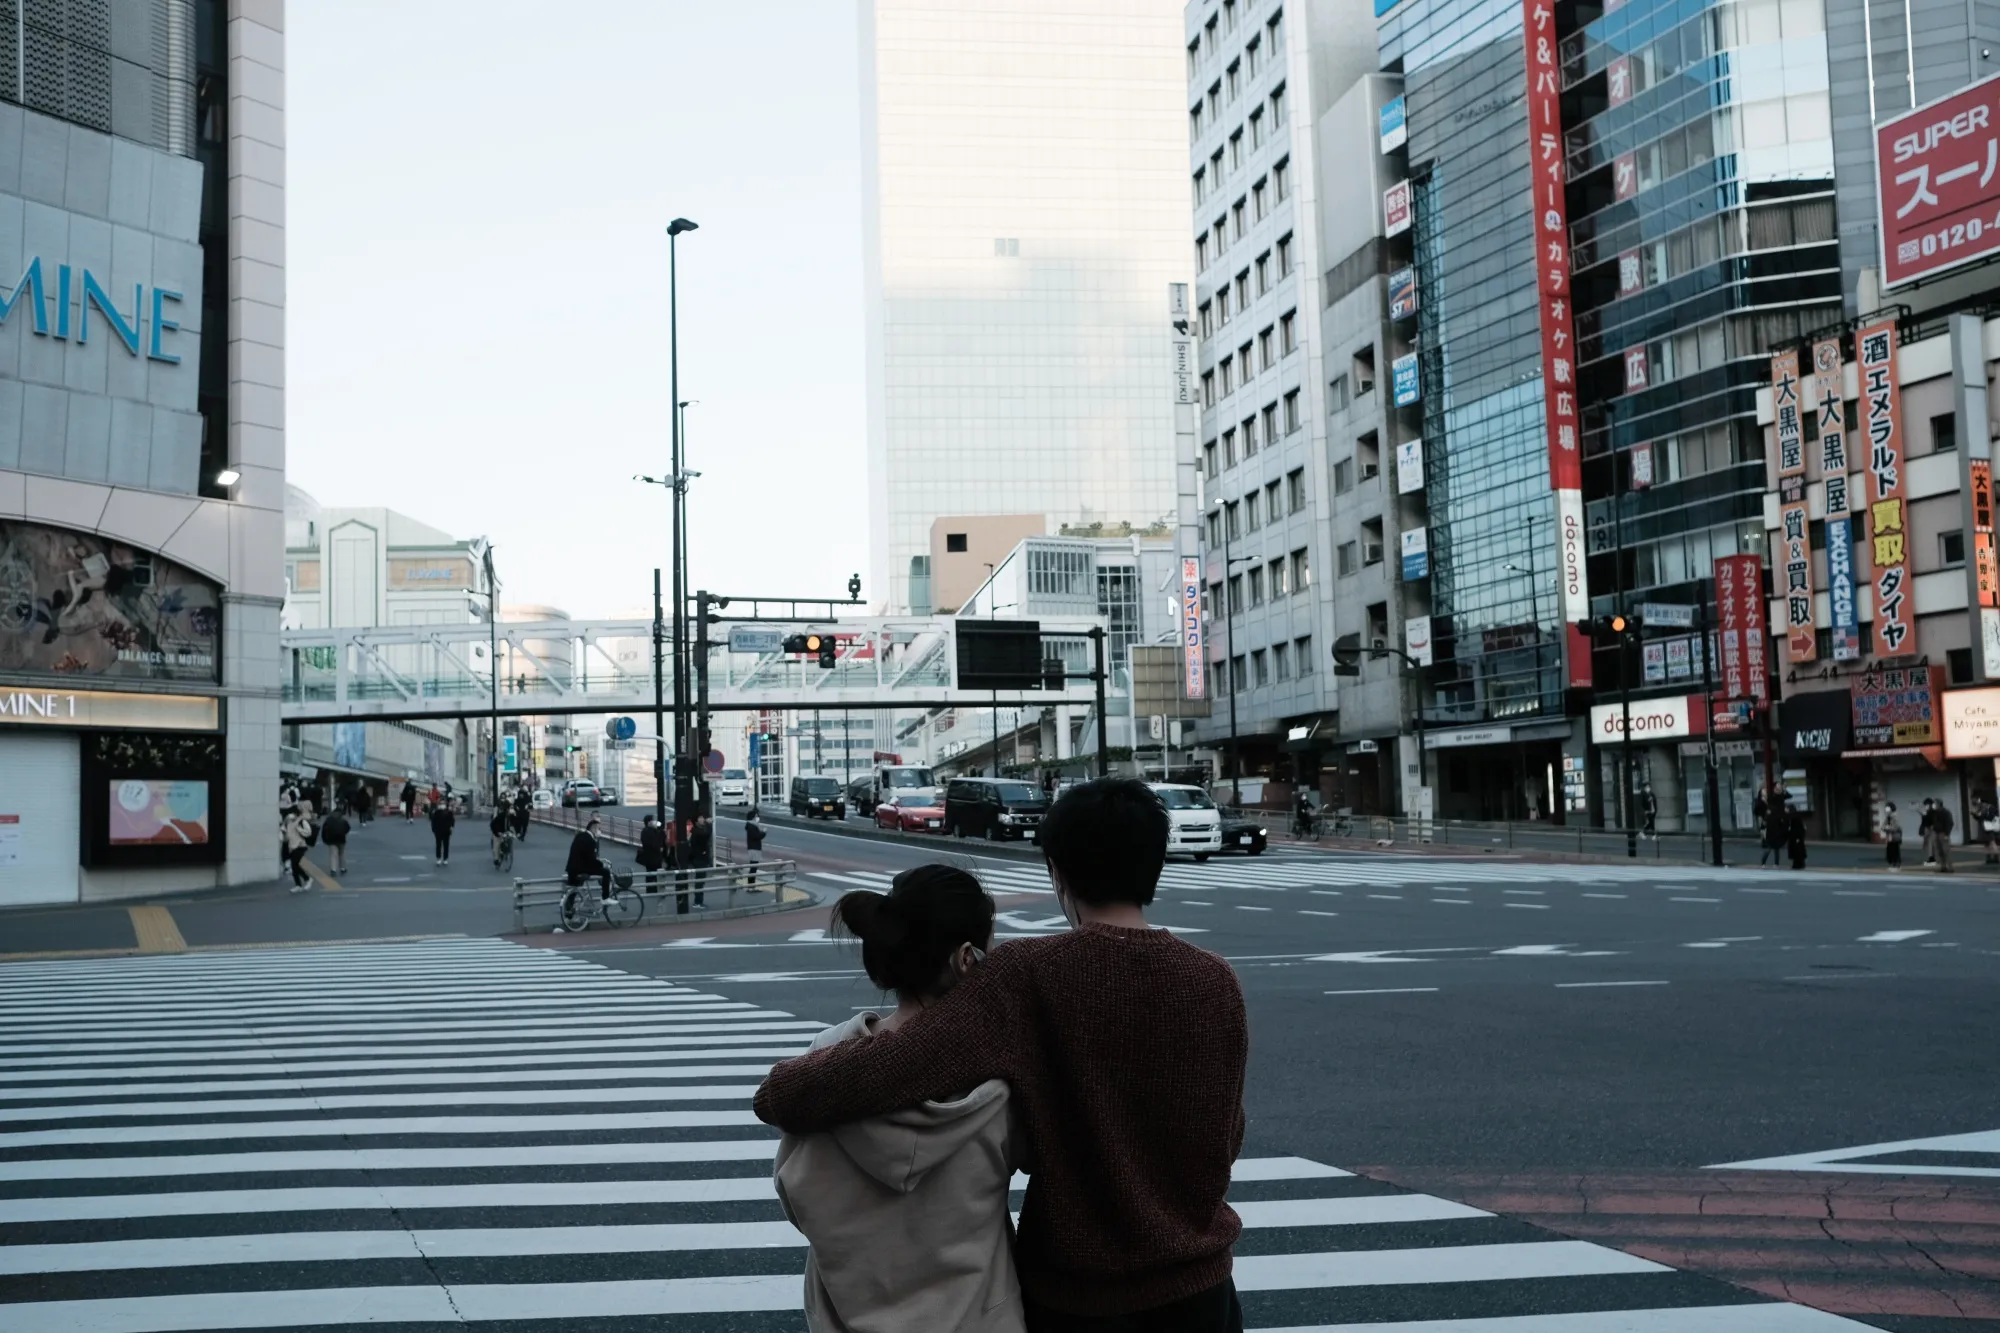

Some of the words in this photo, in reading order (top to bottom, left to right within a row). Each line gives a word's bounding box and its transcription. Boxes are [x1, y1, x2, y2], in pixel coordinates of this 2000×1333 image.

[1893, 104, 1989, 164] SUPER
[1178, 345, 1188, 401] SHINJUKU
[1776, 373, 1801, 470] 大黒屋
[1819, 389, 1848, 518] 大黒屋
[1565, 515, 1579, 595] docomo
[1830, 521, 1853, 627] EXCHANGE
[1186, 586, 1199, 647] ダイコク
[1720, 562, 1737, 629] カラオケ
[1743, 560, 1760, 627] カラオケ
[117, 650, 161, 663] BALANCE
[165, 653, 175, 664] IN
[179, 654, 212, 666] MOTION
[1861, 667, 1929, 691] 大黒屋
[66, 695, 75, 718] 1
[1856, 726, 1893, 737] EXCHANGE
[1954, 717, 1999, 731] Miyama
[1965, 706, 1987, 716] Cafe
